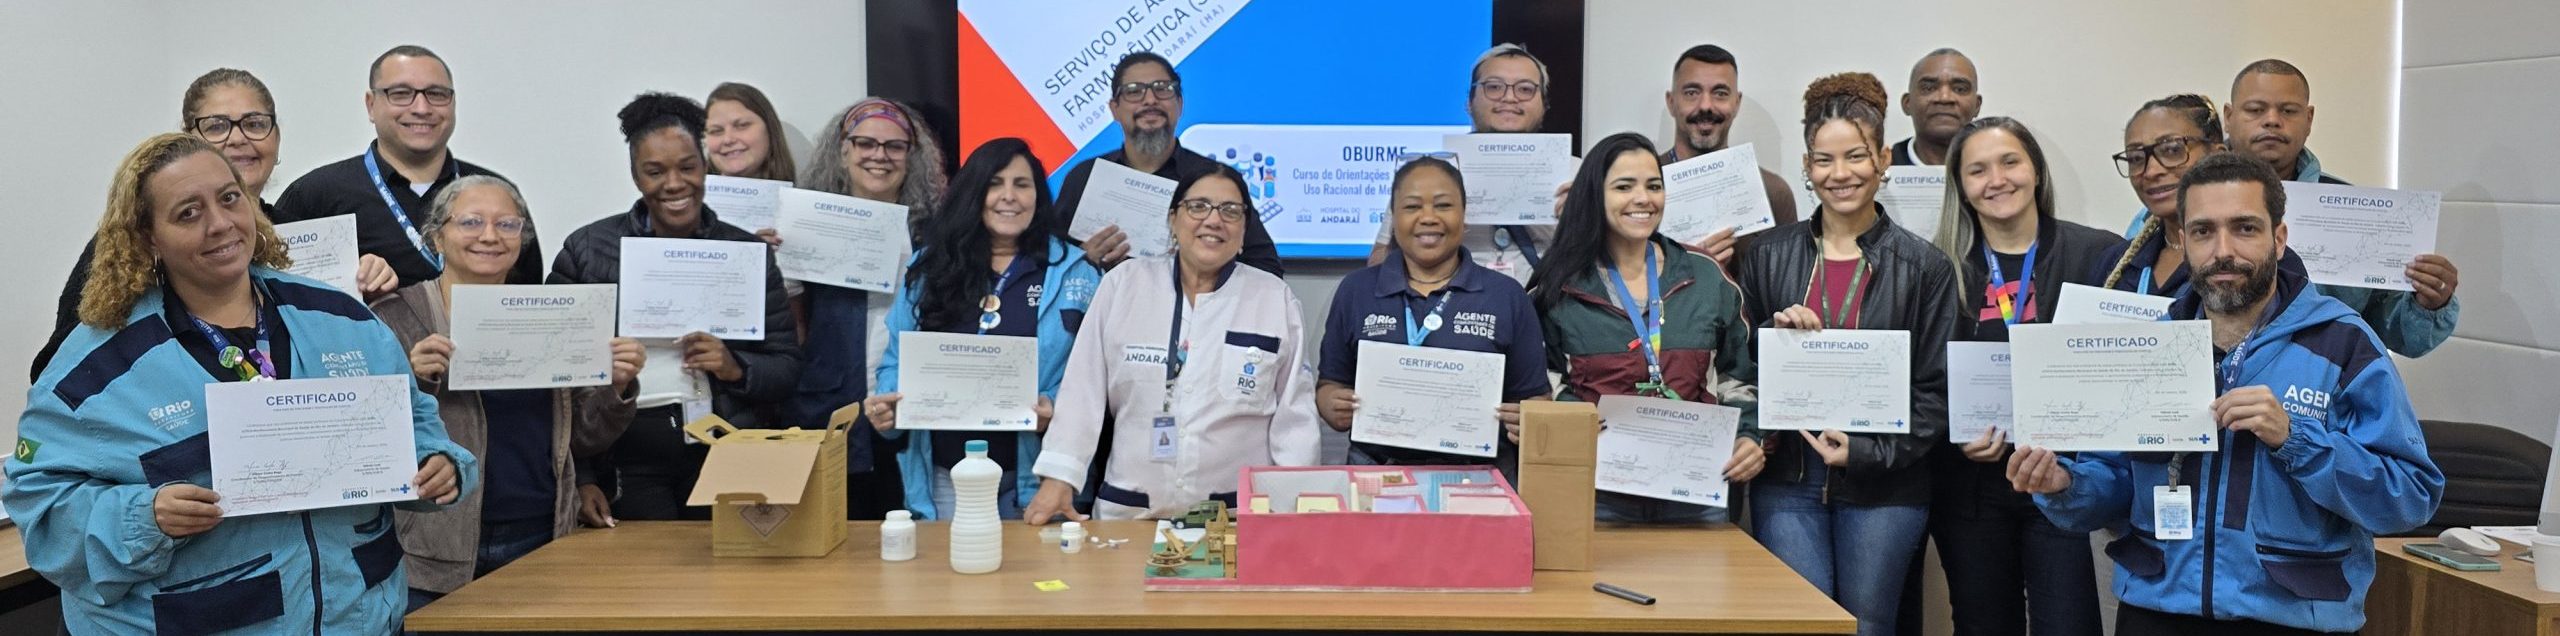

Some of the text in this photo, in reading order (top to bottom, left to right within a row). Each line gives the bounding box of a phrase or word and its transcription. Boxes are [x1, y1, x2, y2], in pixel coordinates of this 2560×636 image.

[1044, 30, 1117, 96] SERVIÇO
[1116, 5, 1145, 34] DE
[1478, 144, 1536, 152] CERTIFICADO
[1293, 168, 1390, 182] Curso de Orientações
[1671, 161, 1724, 181] CERTIFICADO
[708, 185, 759, 196] ERTIFICADO
[1304, 184, 1321, 195] Uso
[1324, 183, 1362, 195] Racional
[1365, 184, 1376, 195] de
[2319, 195, 2393, 208] CERTIFICADO
[814, 202, 873, 218] CERTIFICADO
[1320, 213, 1360, 223] ANDARAÍ
[664, 250, 728, 260] CERTIFICADO
[501, 297, 575, 306] CERTIFICADO
[2099, 301, 2163, 318] CERTIFICADO
[1454, 312, 1496, 324] AGENTE
[1454, 325, 1496, 339] SAÚDE
[939, 343, 1001, 354] CERTIFICADO
[1801, 341, 1869, 350] CERTIFICADO
[2066, 337, 2158, 348] CERTIFICADO
[1125, 353, 1167, 364] ANDARA
[1399, 357, 1464, 371] CERTIFICADO
[266, 392, 357, 407] CERTIFICADO
[1636, 406, 1699, 421] CERTIFICADO
[2282, 401, 2327, 420] COMUNIT
[2147, 436, 2165, 445] RIO
[351, 489, 368, 499] RIO
